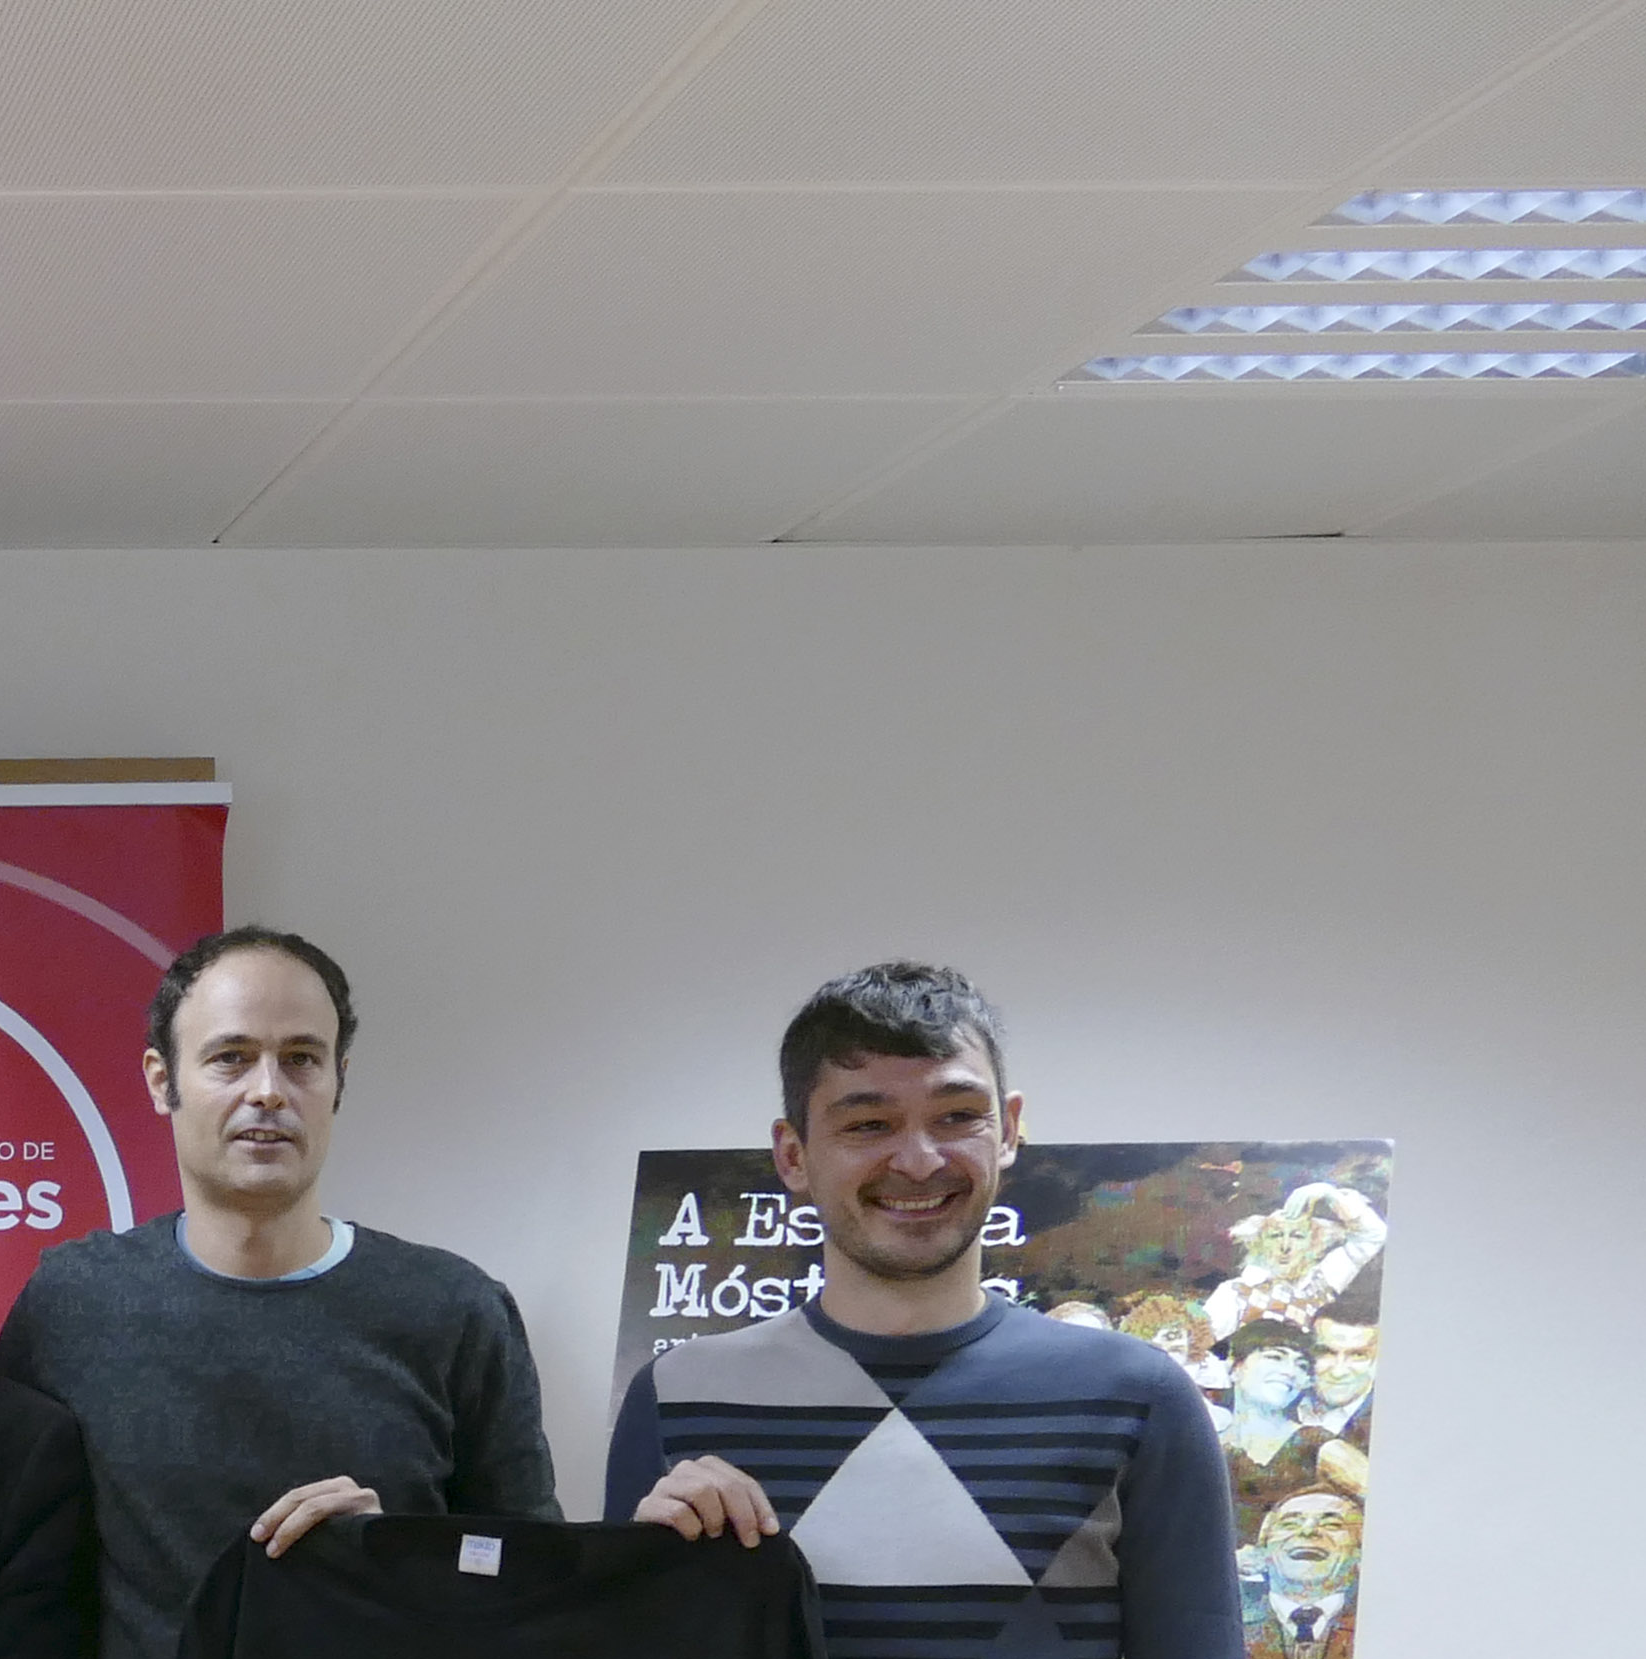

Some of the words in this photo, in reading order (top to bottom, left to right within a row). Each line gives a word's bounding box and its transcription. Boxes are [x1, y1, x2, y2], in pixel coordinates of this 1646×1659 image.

[23, 1142, 55, 1161] DE
[658, 1192, 710, 1247] A
[734, 1192, 1027, 1248] Esa
[649, 1263, 1022, 1318] Mósts
